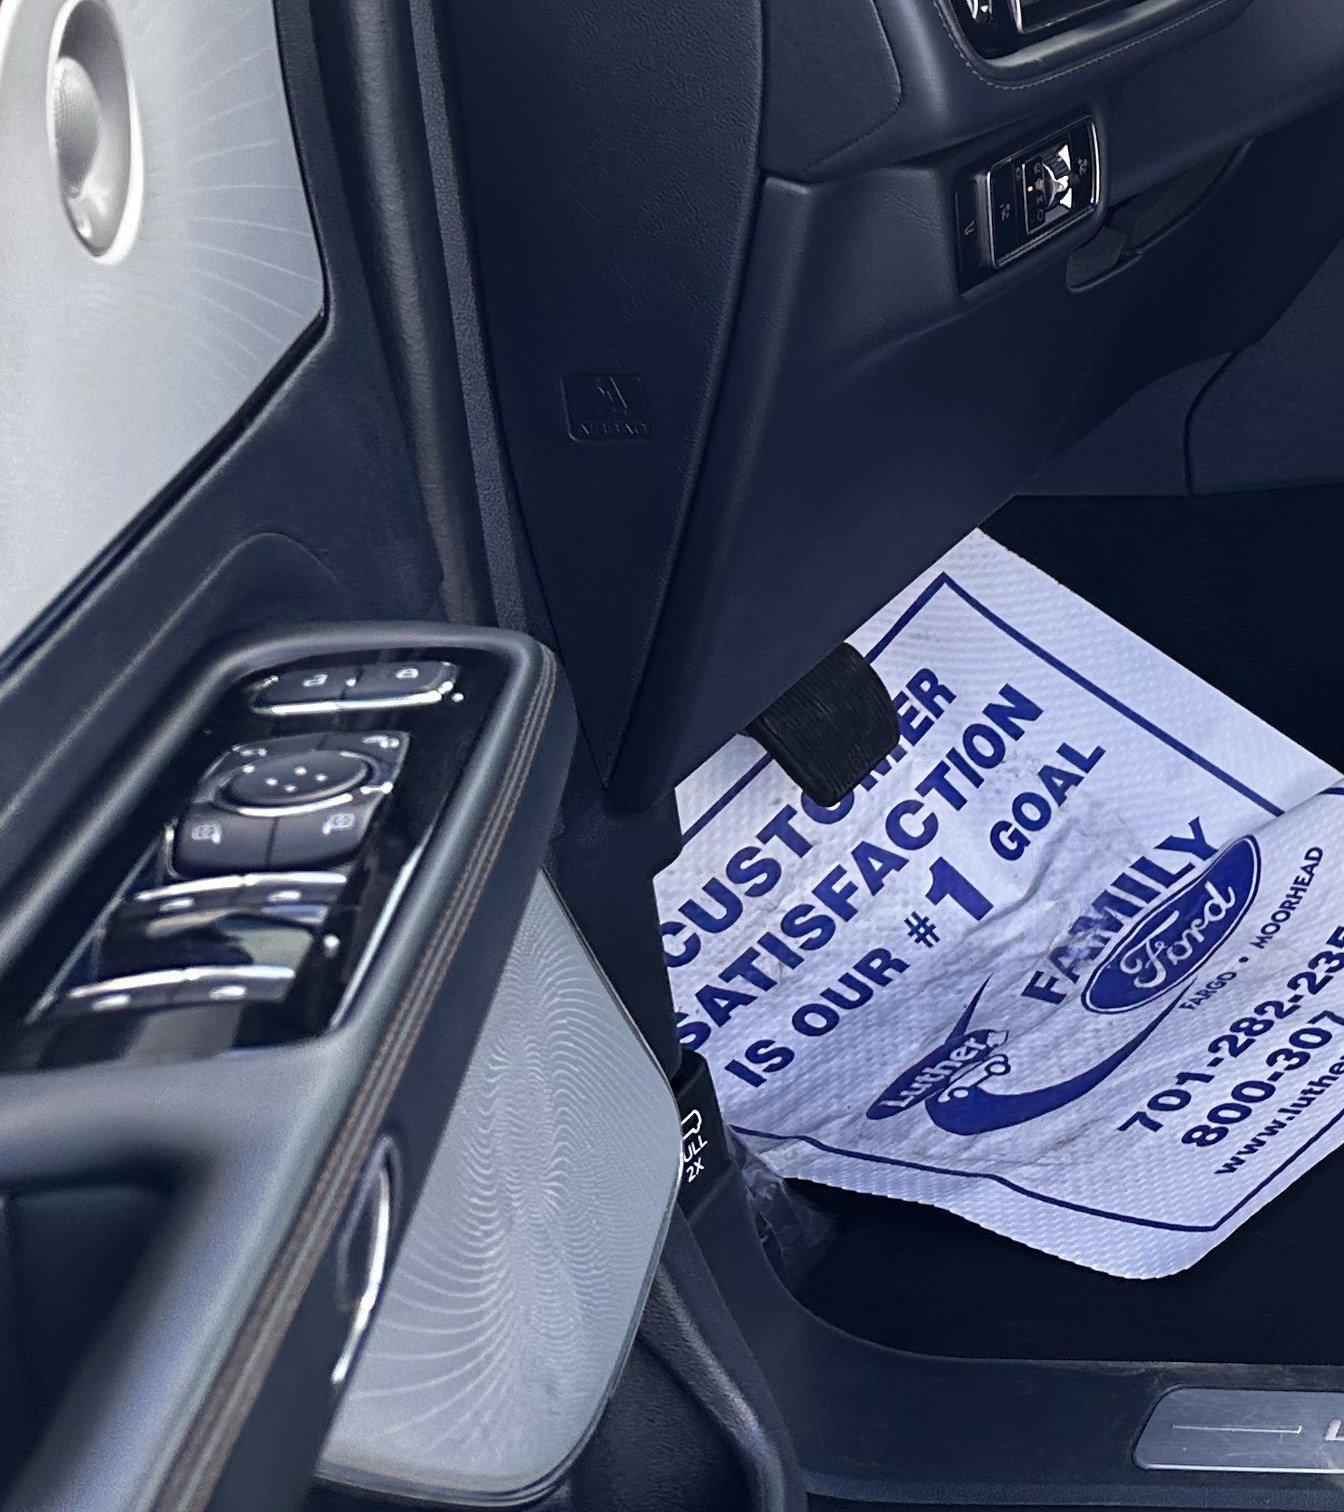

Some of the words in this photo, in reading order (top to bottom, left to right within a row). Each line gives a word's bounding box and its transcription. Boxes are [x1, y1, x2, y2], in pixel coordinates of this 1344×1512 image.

[675, 683, 1044, 1050] SATISFACTION
[724, 1039, 795, 1088] IS
[791, 947, 910, 1037] OUR
[989, 741, 1104, 861] GOAL
[1021, 816, 1220, 1005] FAMILY
[1120, 881, 1236, 989] Ford
[1178, 971, 1238, 1011] FARGO
[1249, 845, 1324, 949] MOORHEAD
[880, 1036, 985, 1109] Luther
[686, 1156, 705, 1183] 2X
